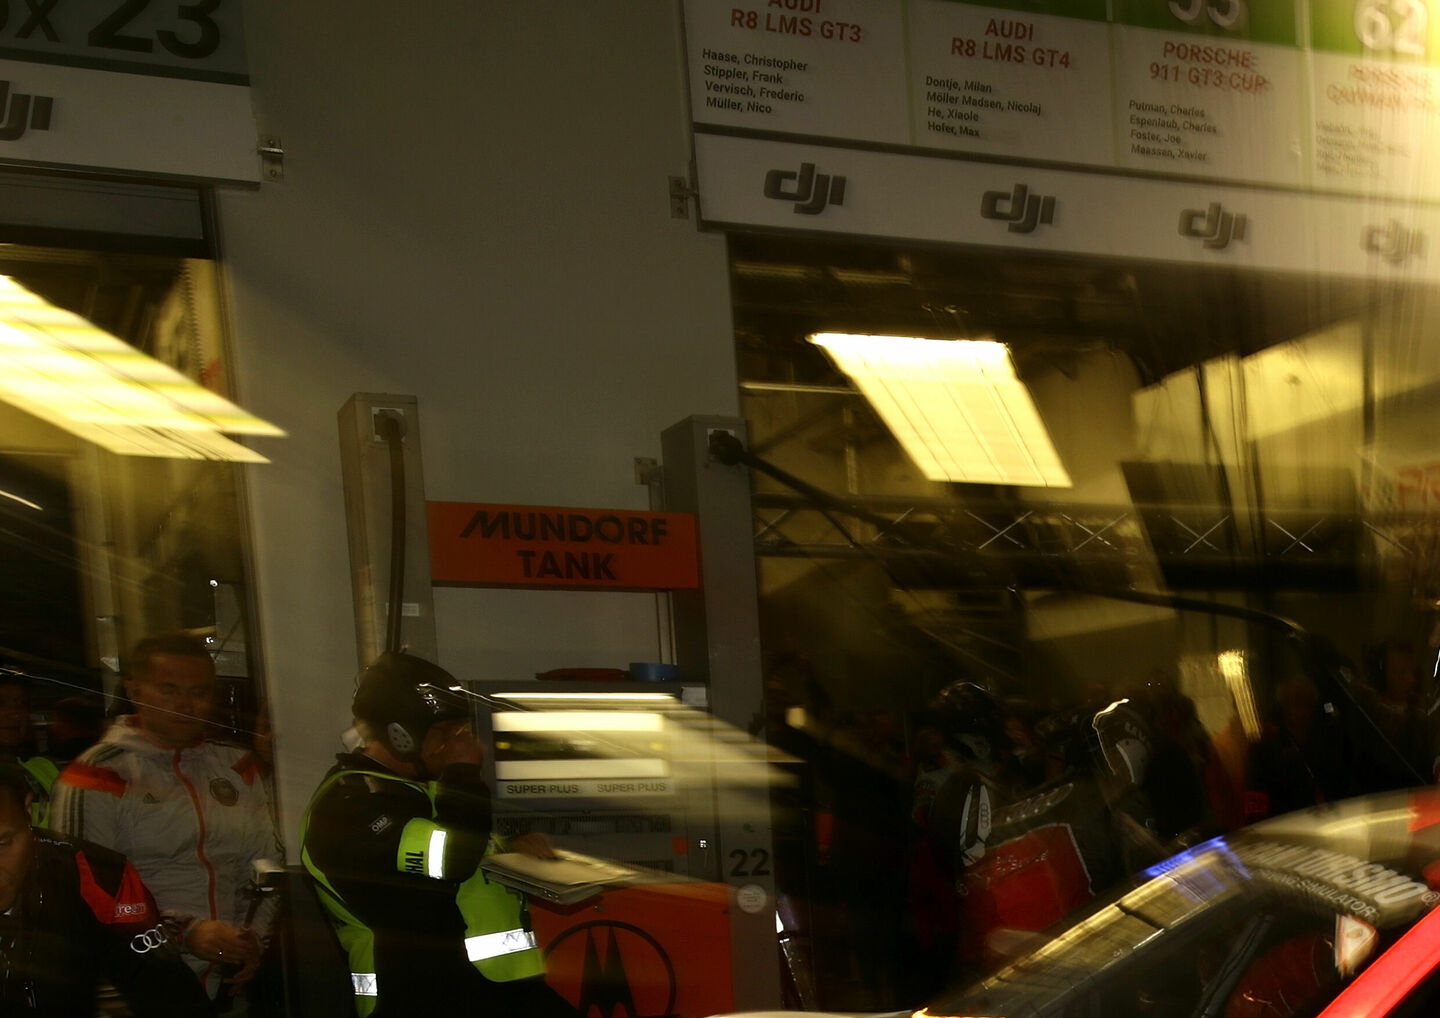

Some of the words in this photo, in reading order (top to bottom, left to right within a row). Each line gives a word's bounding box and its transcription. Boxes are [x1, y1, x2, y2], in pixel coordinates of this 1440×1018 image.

[731, 8, 758, 30] R8
[765, 12, 813, 37] LMS
[820, 20, 862, 43] GT3
[985, 18, 1034, 42] AUDI
[1354, 0, 1428, 56] 62
[702, 48, 740, 65] Haase,
[744, 53, 808, 72] Christopher
[951, 37, 976, 57] R8
[983, 41, 1026, 64] LMS
[1032, 48, 1071, 69] GT4
[1163, 41, 1254, 68] PORSCHE
[704, 64, 749, 83] Stippler,
[752, 70, 784, 85] Frank
[926, 75, 961, 92] Dontje,
[964, 79, 992, 94] Milan
[1150, 62, 1180, 82] 911
[1188, 67, 1223, 87] GT3
[1229, 72, 1268, 91] CUP
[705, 80, 756, 98] Vervisch,
[759, 86, 805, 103] Frederic
[706, 96, 743, 113] Müller,
[747, 102, 772, 115] Nico
[926, 91, 959, 105] Möller
[962, 96, 1004, 111] Madsen,
[1007, 101, 1042, 117] Nicolaj
[928, 107, 944, 119] He,
[947, 109, 979, 122] Xiaole
[1129, 100, 1167, 116] Putman,
[1170, 104, 1205, 118] Charles
[928, 121, 957, 136] Hofer,
[959, 126, 980, 138] Max
[1130, 130, 1163, 143] Foster,
[1165, 134, 1182, 145] Joe
[1182, 121, 1217, 135] Charles
[1178, 149, 1207, 162] Xavier
[459, 510, 668, 545] MUNDORF
[517, 550, 617, 581] TANK
[507, 785, 546, 794] SUPER
[550, 784, 579, 794] PLUS
[597, 783, 634, 793] SUPER
[638, 782, 667, 793] PLUS
[729, 848, 770, 877] 22
[1297, 880, 1377, 916] SIMULATOR
